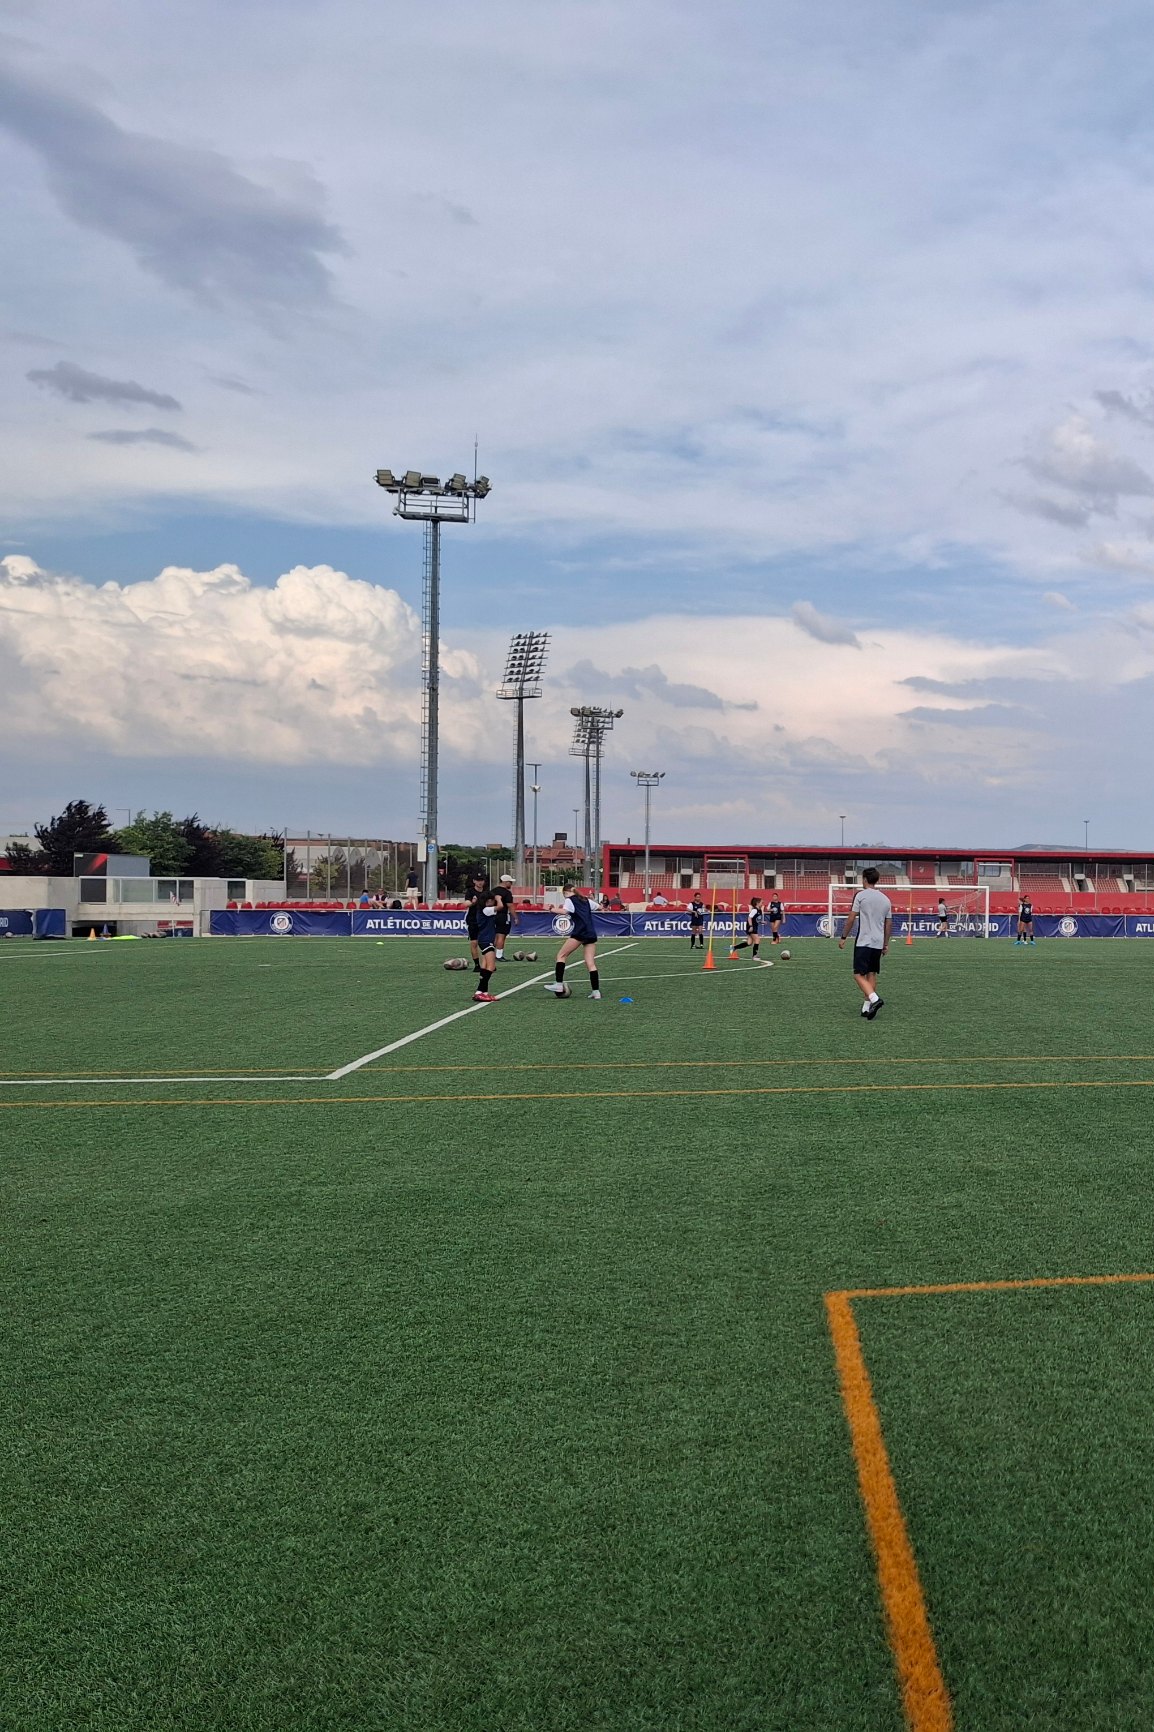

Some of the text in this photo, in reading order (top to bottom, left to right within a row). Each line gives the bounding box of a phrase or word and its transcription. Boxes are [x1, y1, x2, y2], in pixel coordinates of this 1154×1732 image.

[366, 916, 420, 929] ATLÉTICO
[433, 919, 468, 930] MADR
[900, 920, 943, 932] ATLÉTIC
